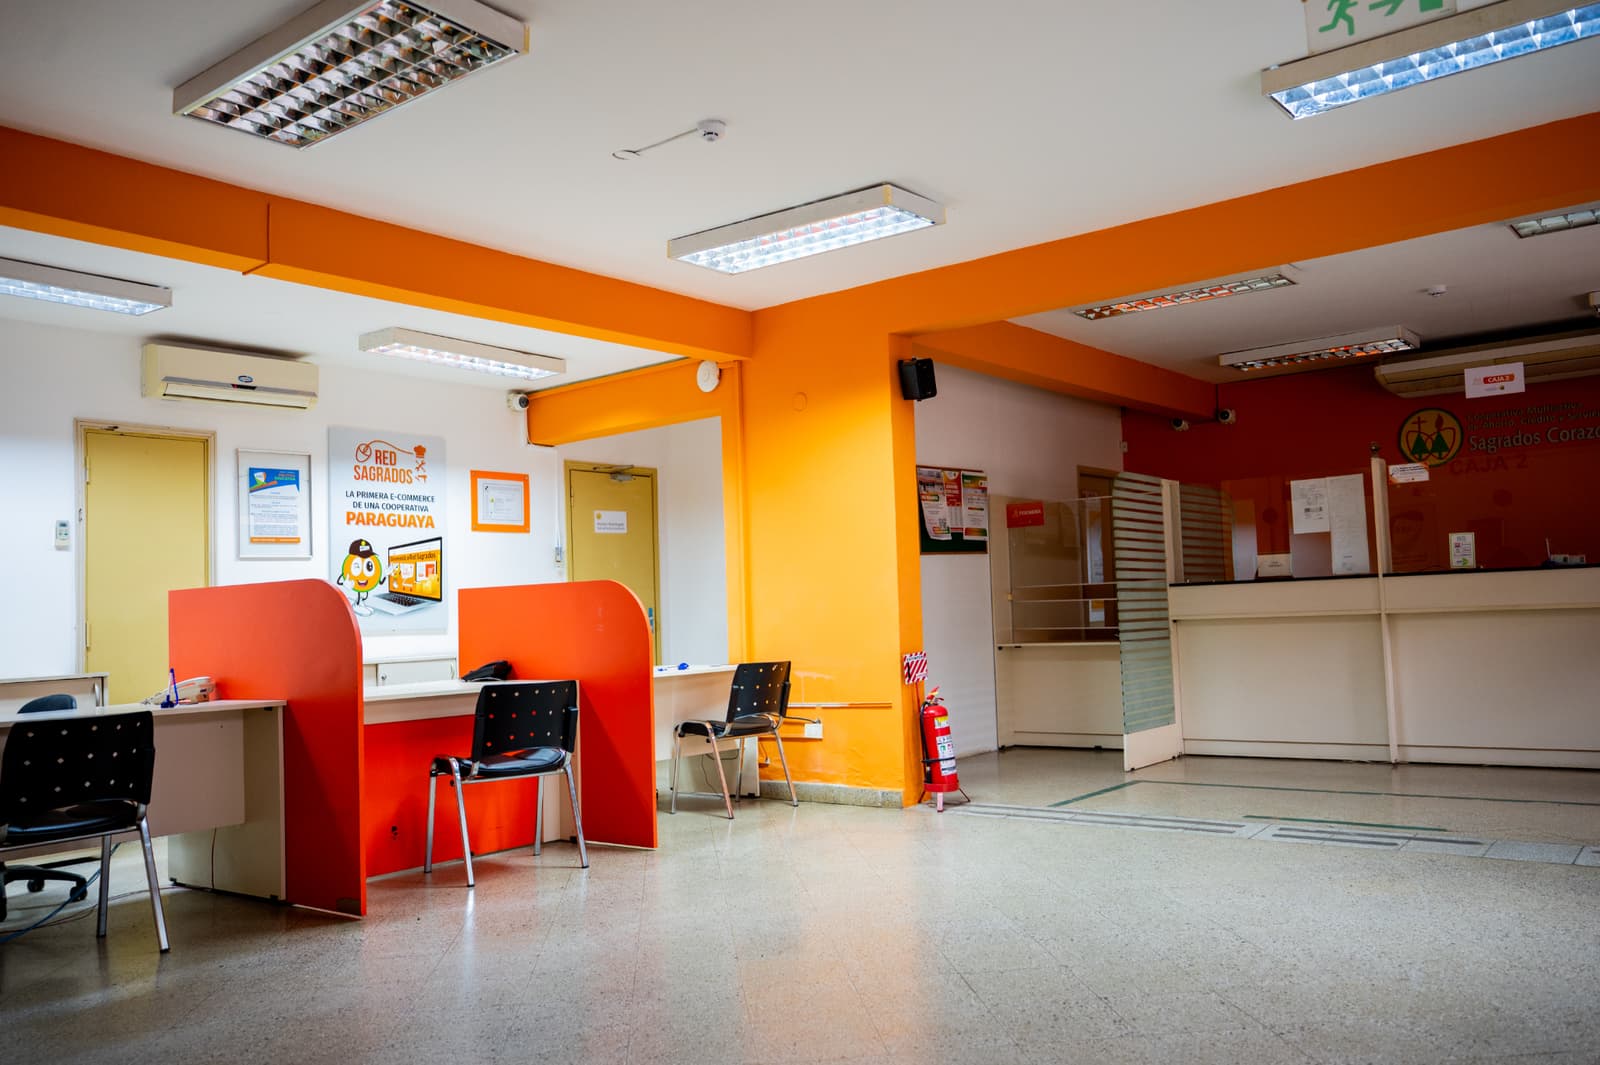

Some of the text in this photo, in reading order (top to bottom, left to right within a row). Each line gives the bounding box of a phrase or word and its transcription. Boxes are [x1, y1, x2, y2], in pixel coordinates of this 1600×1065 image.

[1487, 376, 1505, 384] CAJA
[1469, 429, 1541, 454] Sagrados
[375, 449, 397, 466] RED
[353, 465, 413, 484] SAGRADOS
[345, 490, 435, 503] LA PRIMERA E-COMMERCE
[352, 501, 429, 512] DE UNA COOPERATIVA
[346, 511, 435, 528] PARAGUAYA
